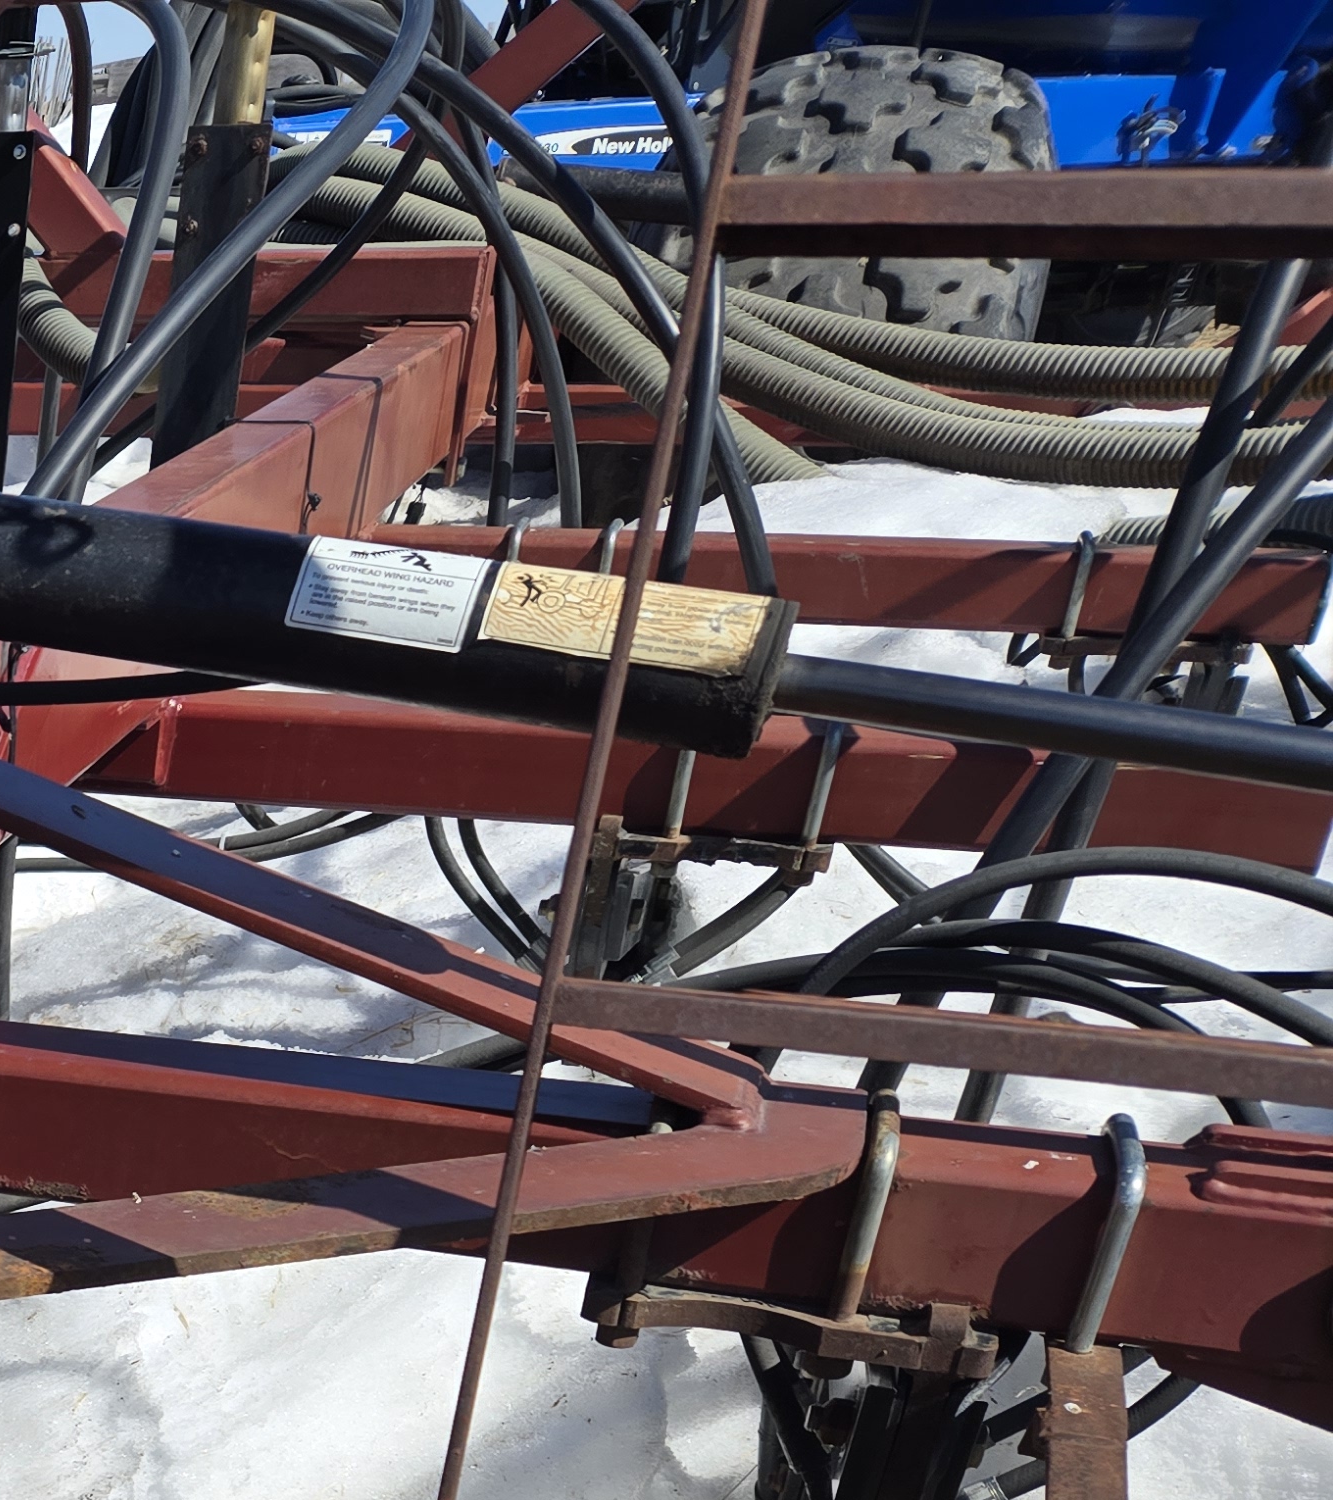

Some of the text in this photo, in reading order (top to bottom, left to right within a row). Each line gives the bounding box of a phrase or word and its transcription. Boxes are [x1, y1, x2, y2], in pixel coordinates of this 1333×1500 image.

[592, 137, 636, 155] New
[327, 564, 454, 587] OVERHEAD WING HAZARD
